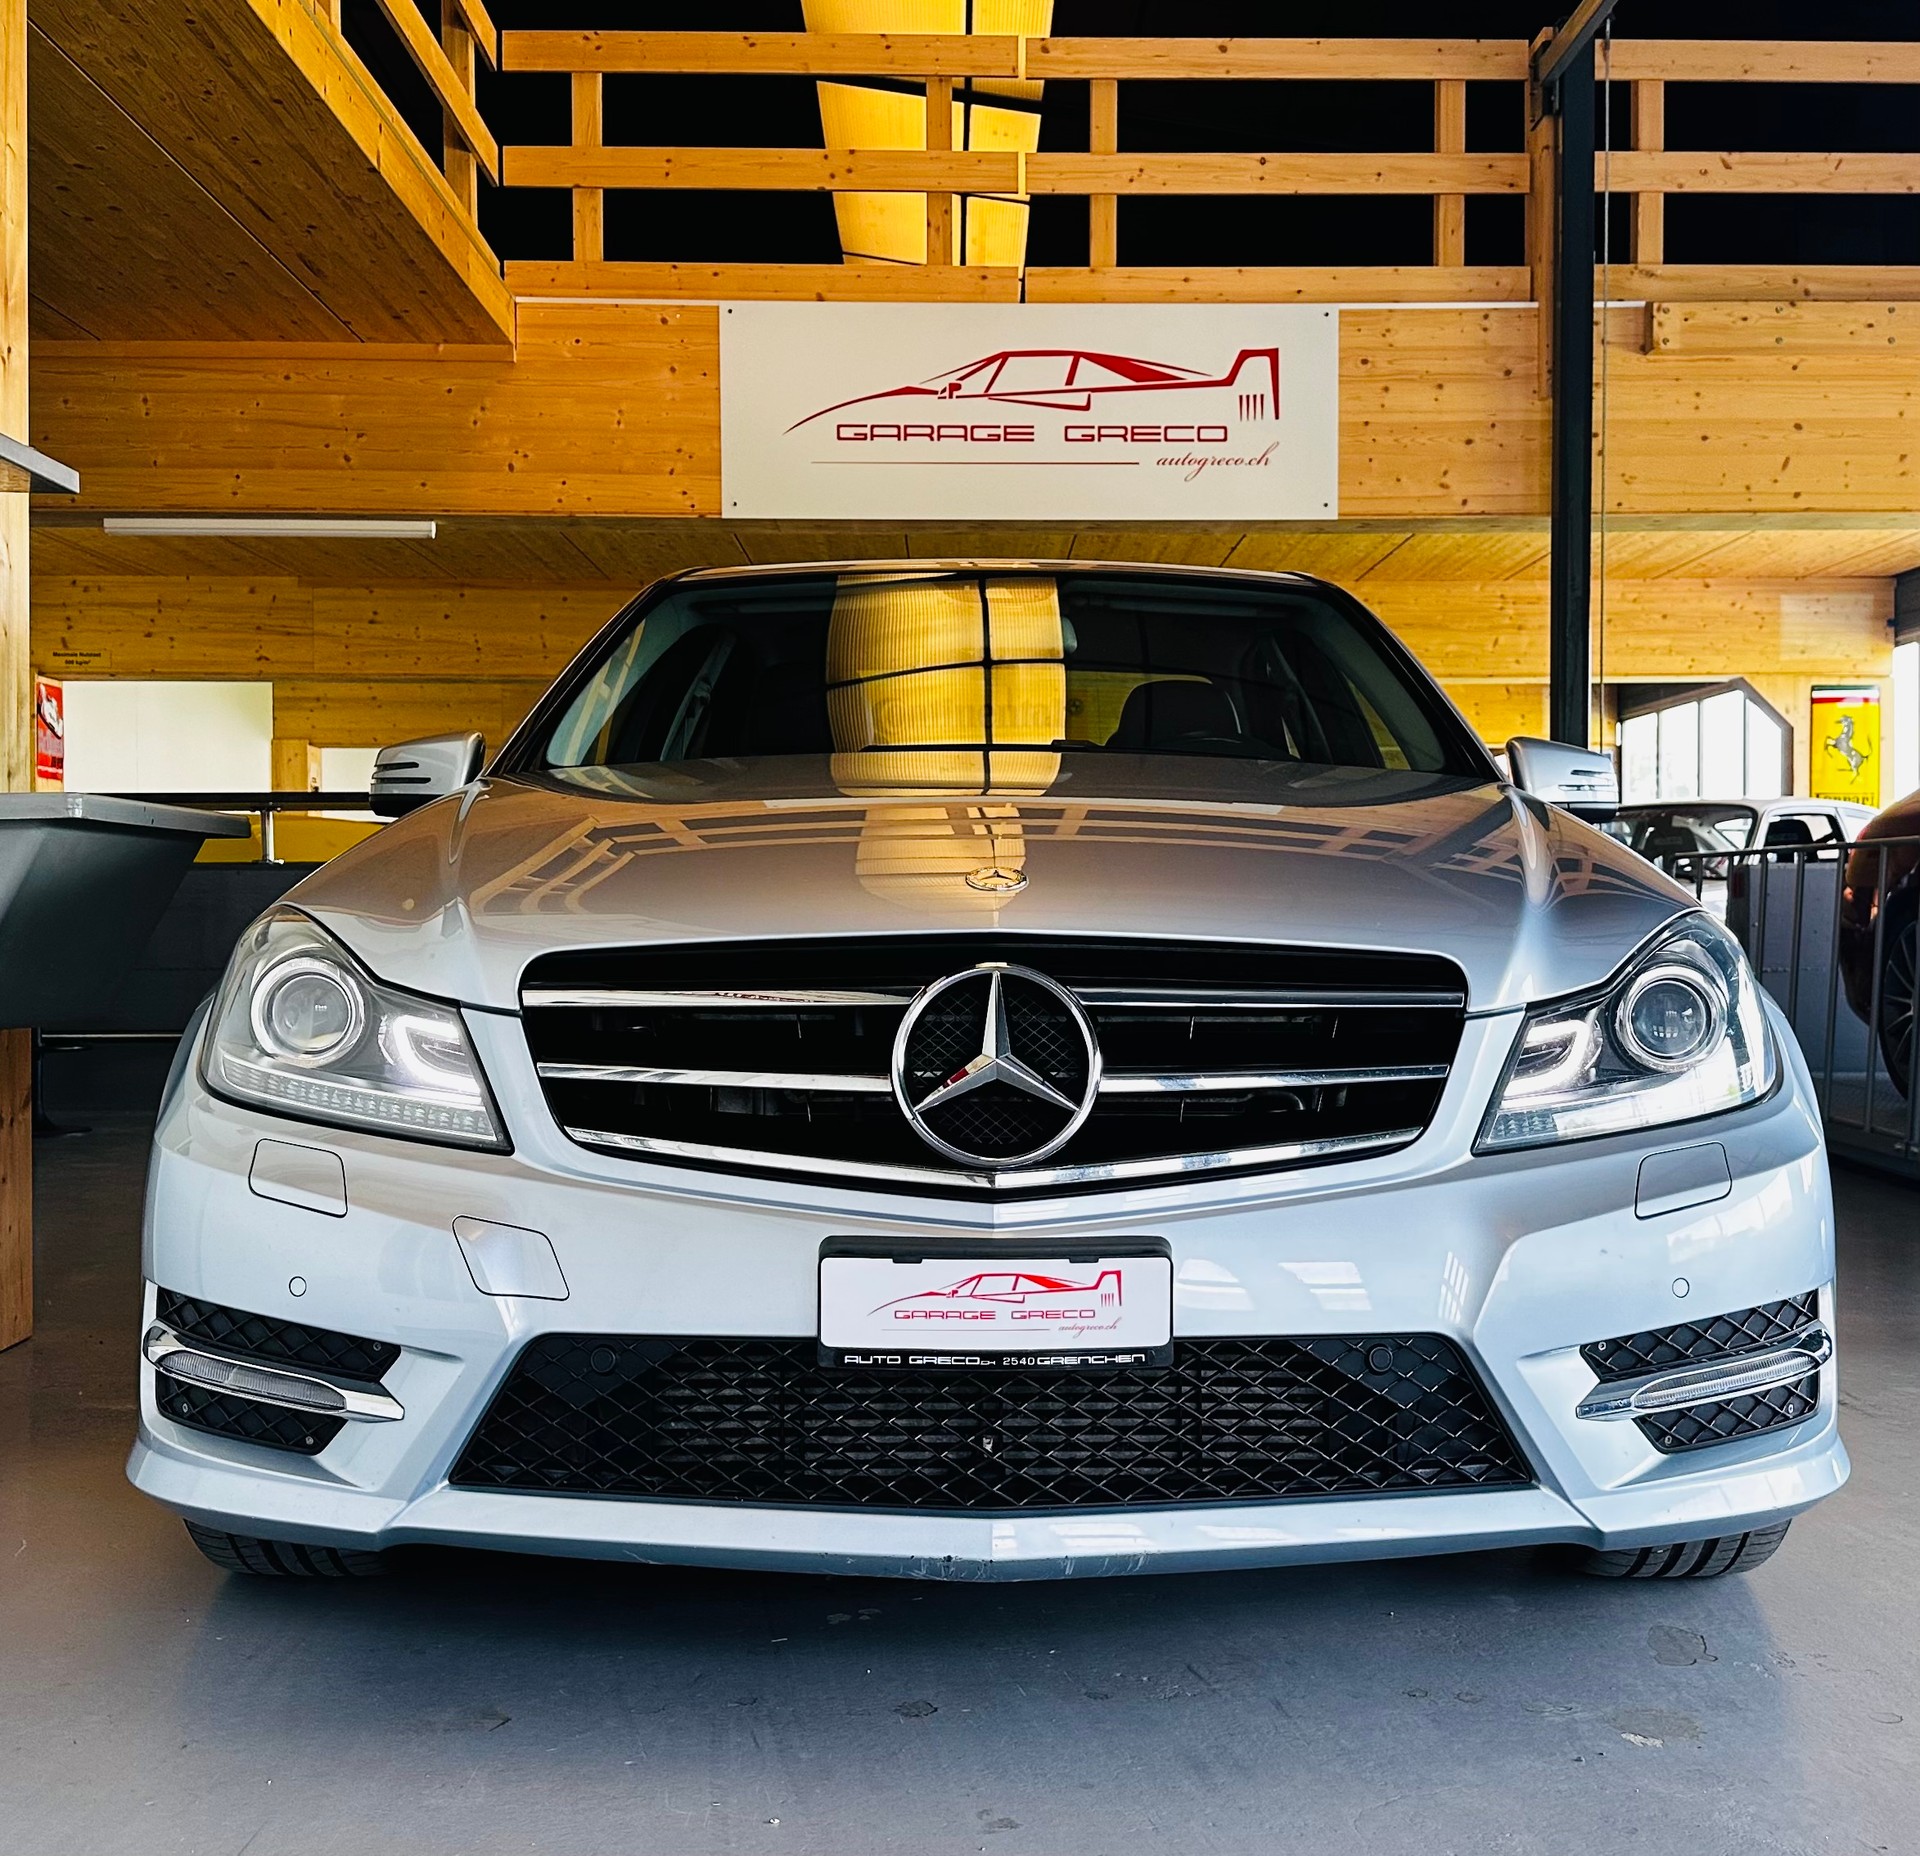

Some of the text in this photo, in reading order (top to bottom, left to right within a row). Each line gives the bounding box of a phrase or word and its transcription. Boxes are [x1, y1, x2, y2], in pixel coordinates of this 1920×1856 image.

[836, 424, 1228, 442] GARAGE GRECO
[1156, 441, 1280, 482] autogreco.ch
[894, 1309, 1096, 1320] GARAGE GRECO
[1058, 1317, 1122, 1339] autogreco.ch
[844, 1355, 901, 1364] AUTO
[1002, 1356, 1036, 1366] 2540
[1036, 1353, 1146, 1365] GRENCHEN
